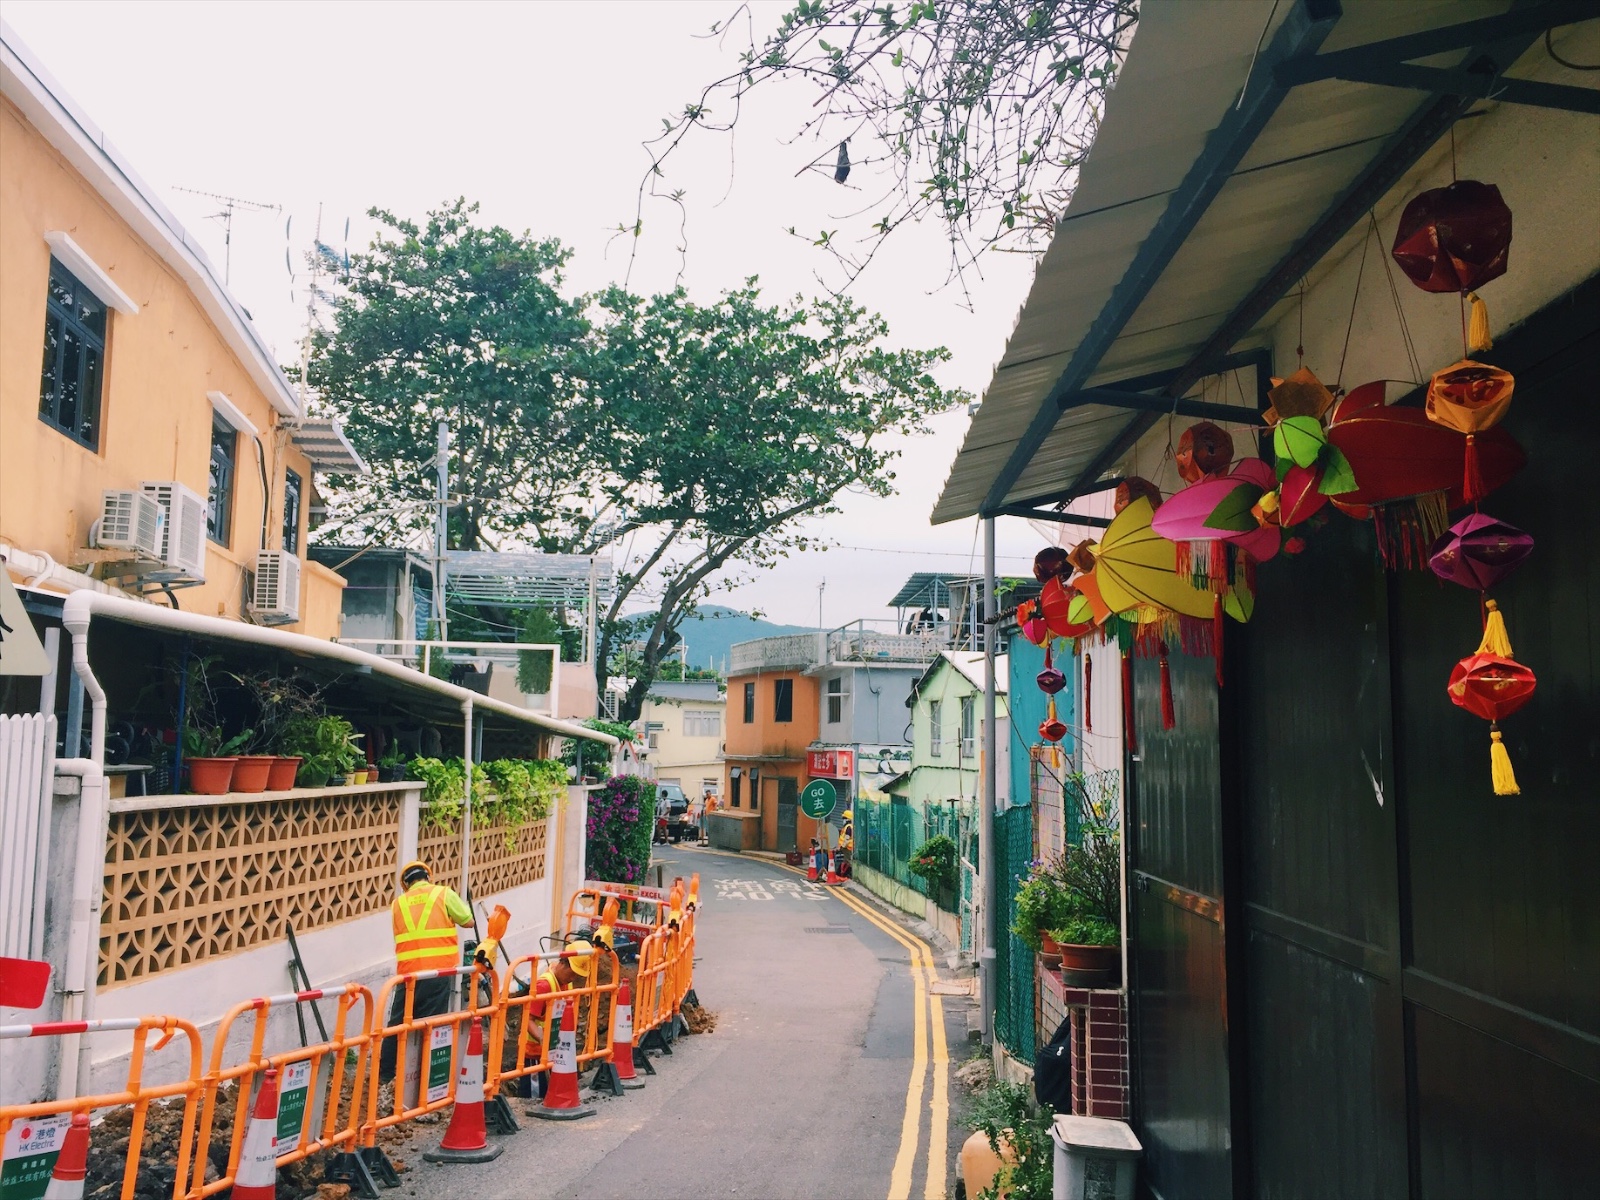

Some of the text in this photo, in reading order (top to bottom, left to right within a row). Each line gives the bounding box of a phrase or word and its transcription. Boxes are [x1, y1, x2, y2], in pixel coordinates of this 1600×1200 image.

[810, 787, 825, 797] GO
[813, 797, 825, 810] 去
[640, 890, 662, 900] EXCEL
[715, 891, 830, 901] SLOW
[35, 1127, 56, 1141] 港燈
[18, 1139, 55, 1153] HK Electric
